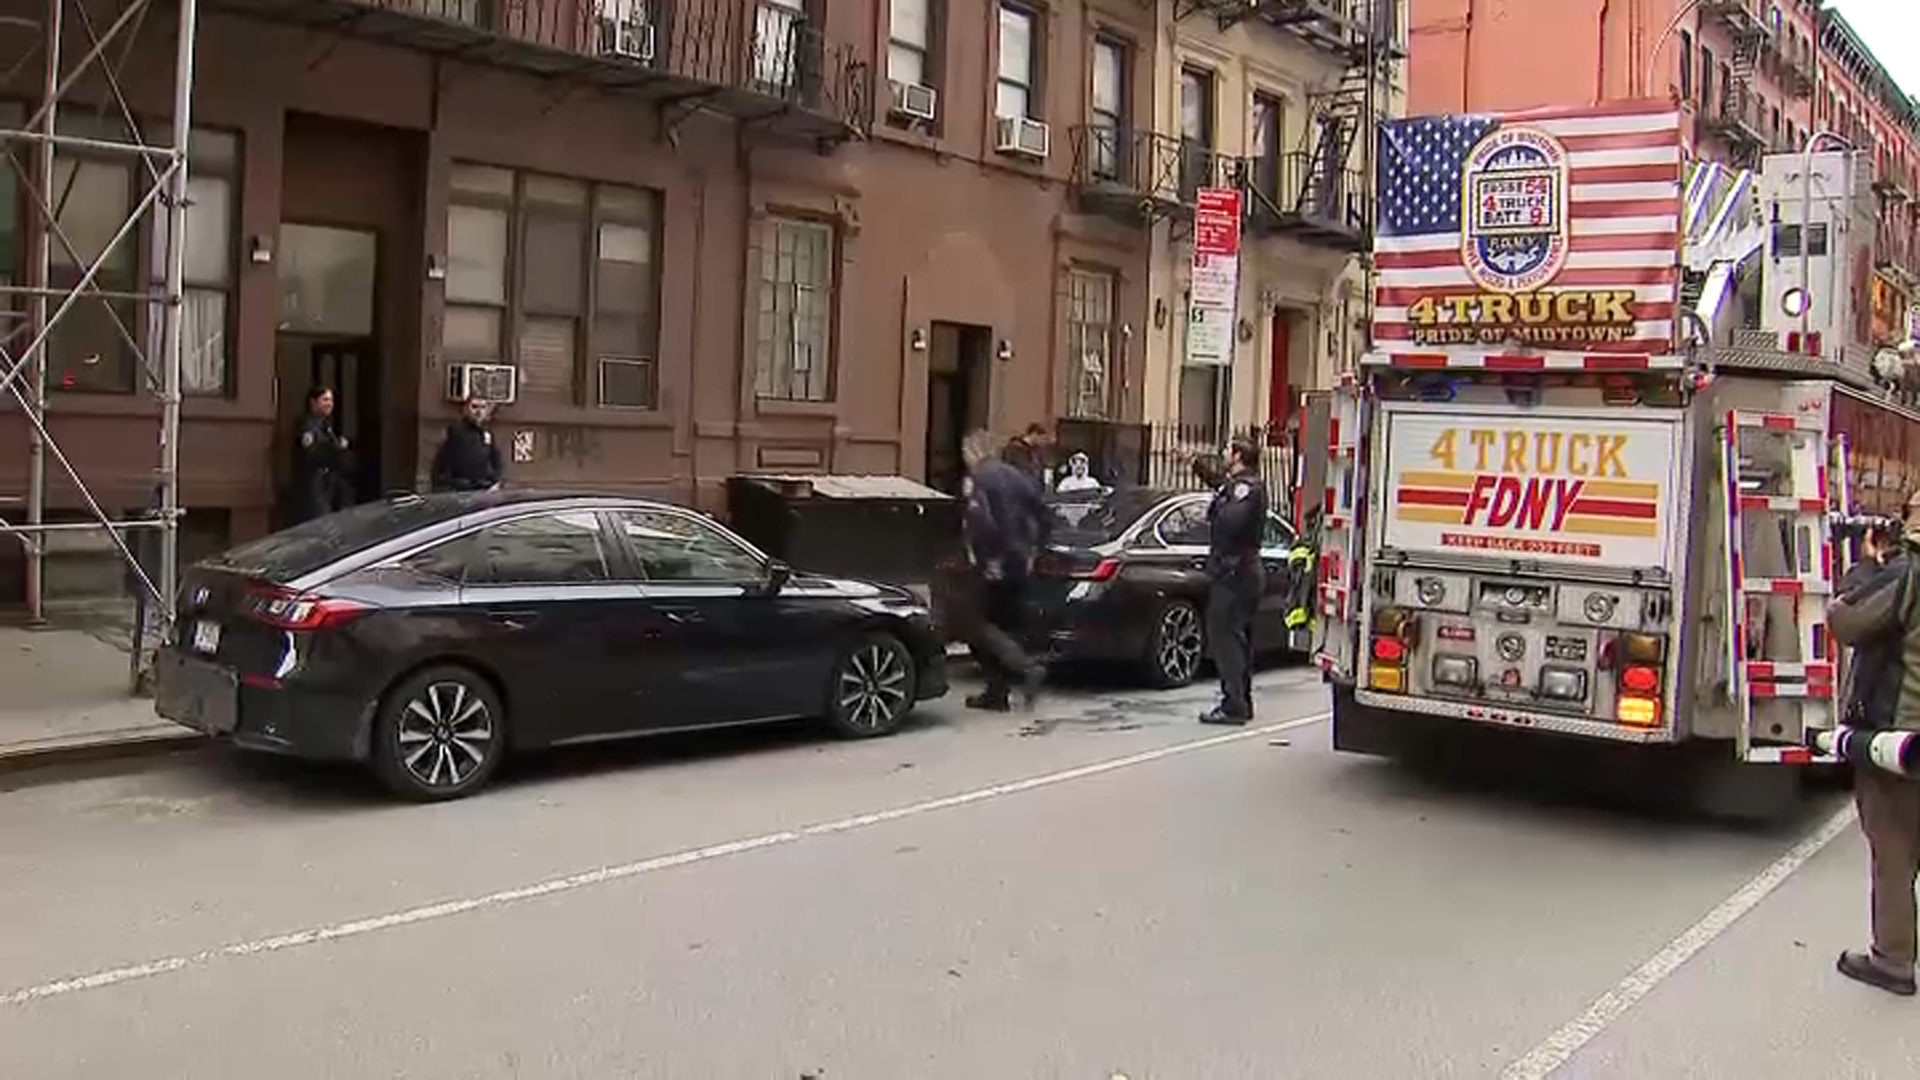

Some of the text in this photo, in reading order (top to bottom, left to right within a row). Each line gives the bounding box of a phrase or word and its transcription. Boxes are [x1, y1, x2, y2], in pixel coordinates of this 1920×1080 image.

[1482, 195, 1546, 212] 4 TRUCK
[1530, 207, 1543, 227] 9
[1409, 289, 1635, 324] 4 TRUCK
[1480, 328, 1505, 342] OF
[1430, 429, 1627, 477] 4 TRUCK
[1464, 475, 1585, 531] FDNY
[1487, 537, 1524, 549] BACK
